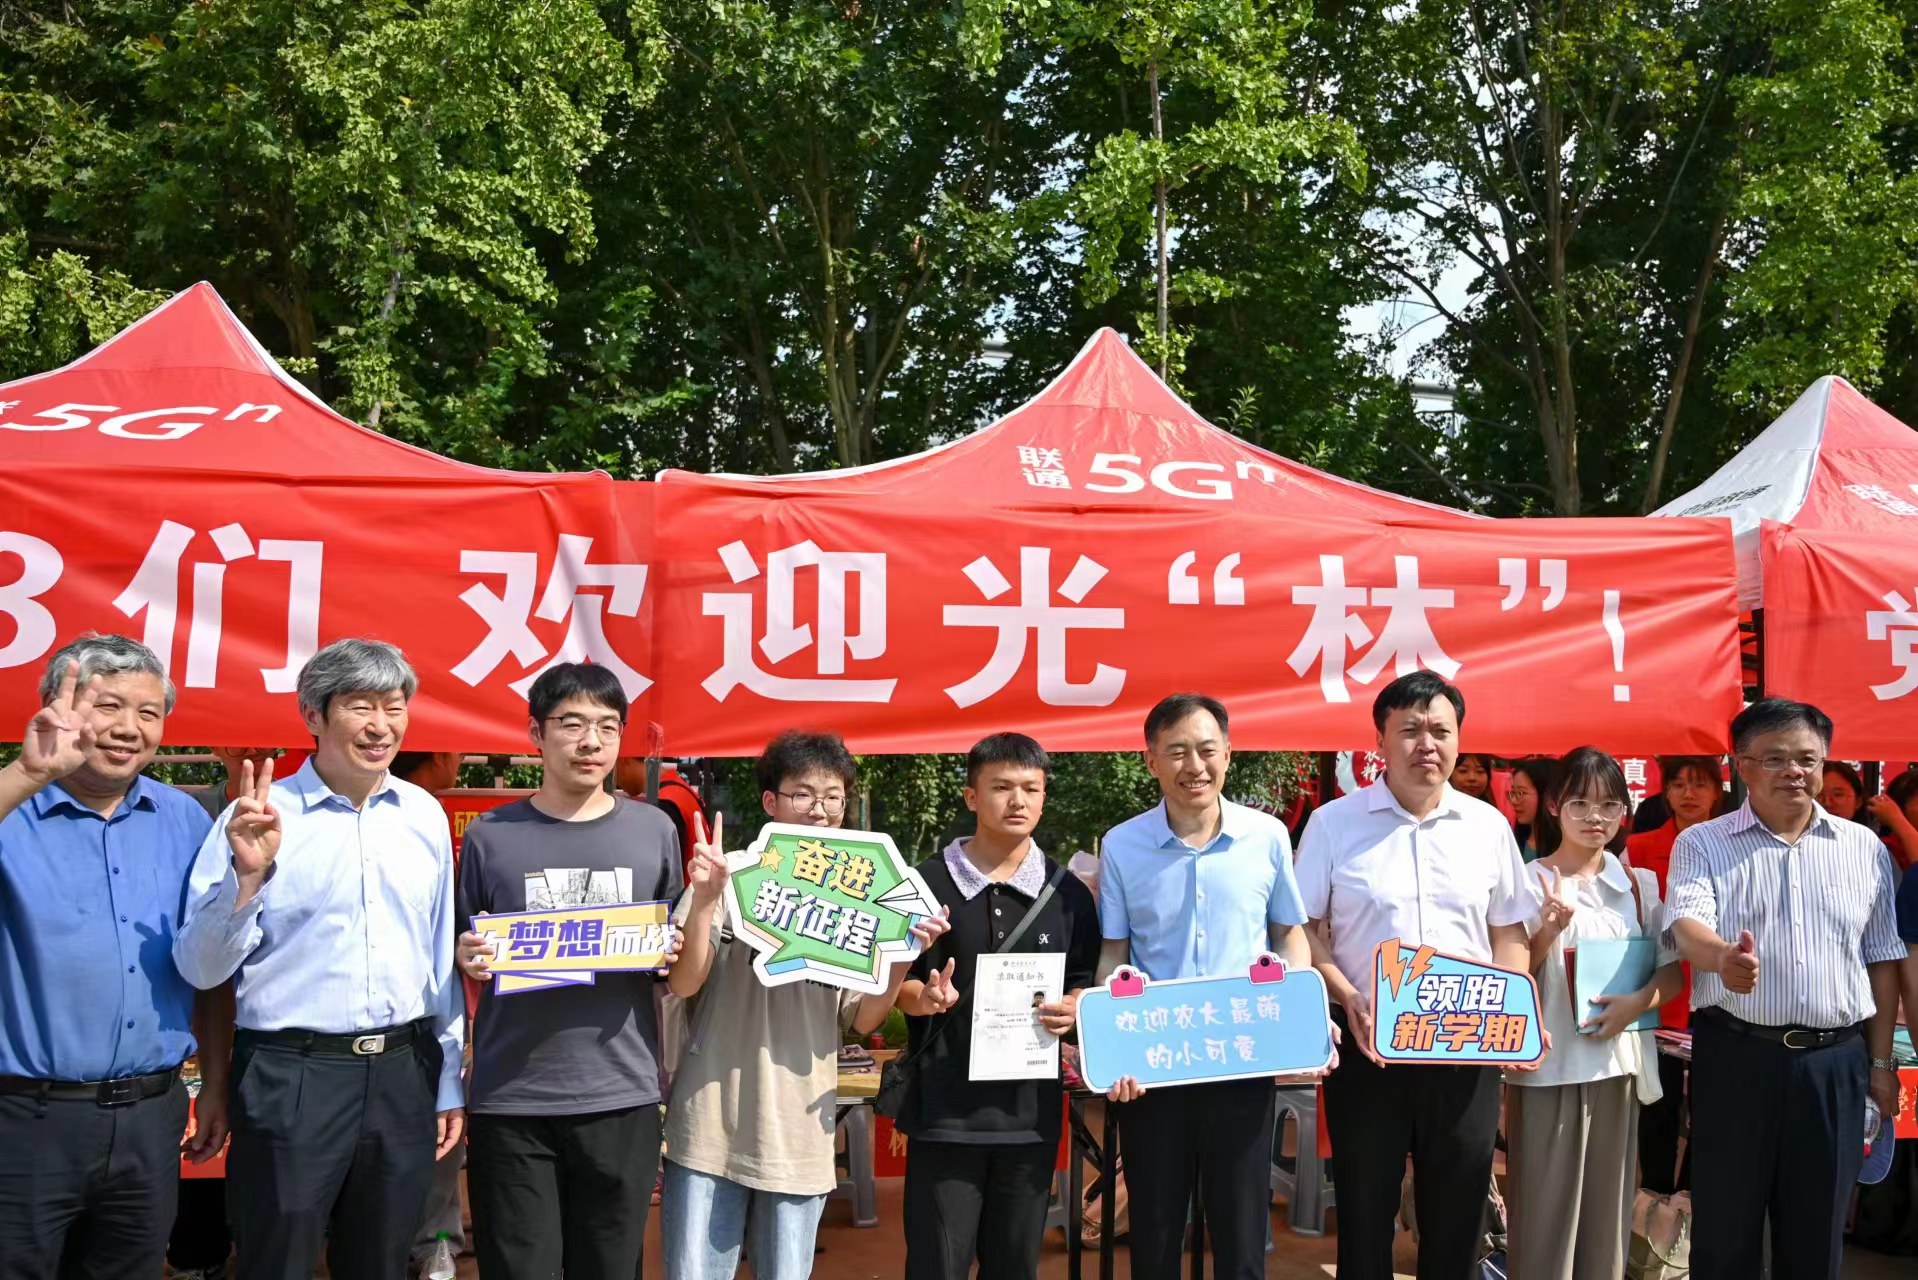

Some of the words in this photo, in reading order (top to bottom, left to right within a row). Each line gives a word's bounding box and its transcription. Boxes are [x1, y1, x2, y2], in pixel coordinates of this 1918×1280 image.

[1613, 758, 1647, 786] 真
[792, 839, 876, 902] 奋进
[751, 879, 880, 958] 新征程
[1115, 994, 1281, 1033] 欢迎农大最萌
[1416, 973, 1508, 1013] 领跑
[1390, 1011, 1528, 1053] 新学期
